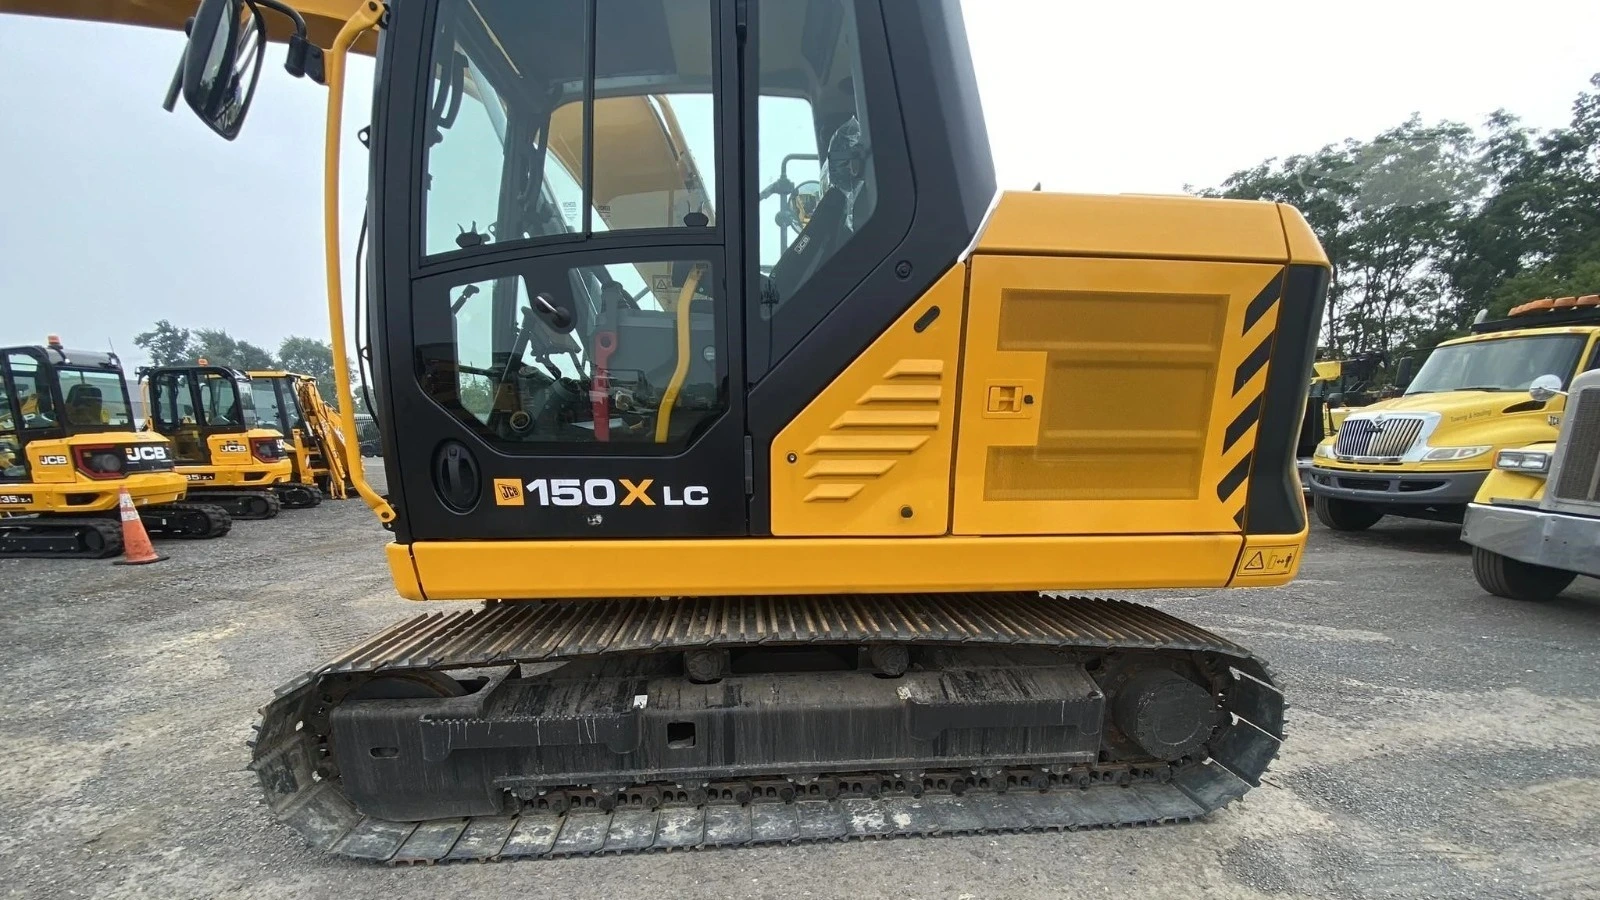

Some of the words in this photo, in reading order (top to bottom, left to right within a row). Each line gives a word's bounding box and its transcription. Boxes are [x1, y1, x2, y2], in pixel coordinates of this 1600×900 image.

[125, 446, 167, 460] JCB
[40, 455, 68, 465] JCB
[0, 495, 18, 503] 35
[501, 485, 520, 499] JCB
[663, 486, 709, 506] LC
